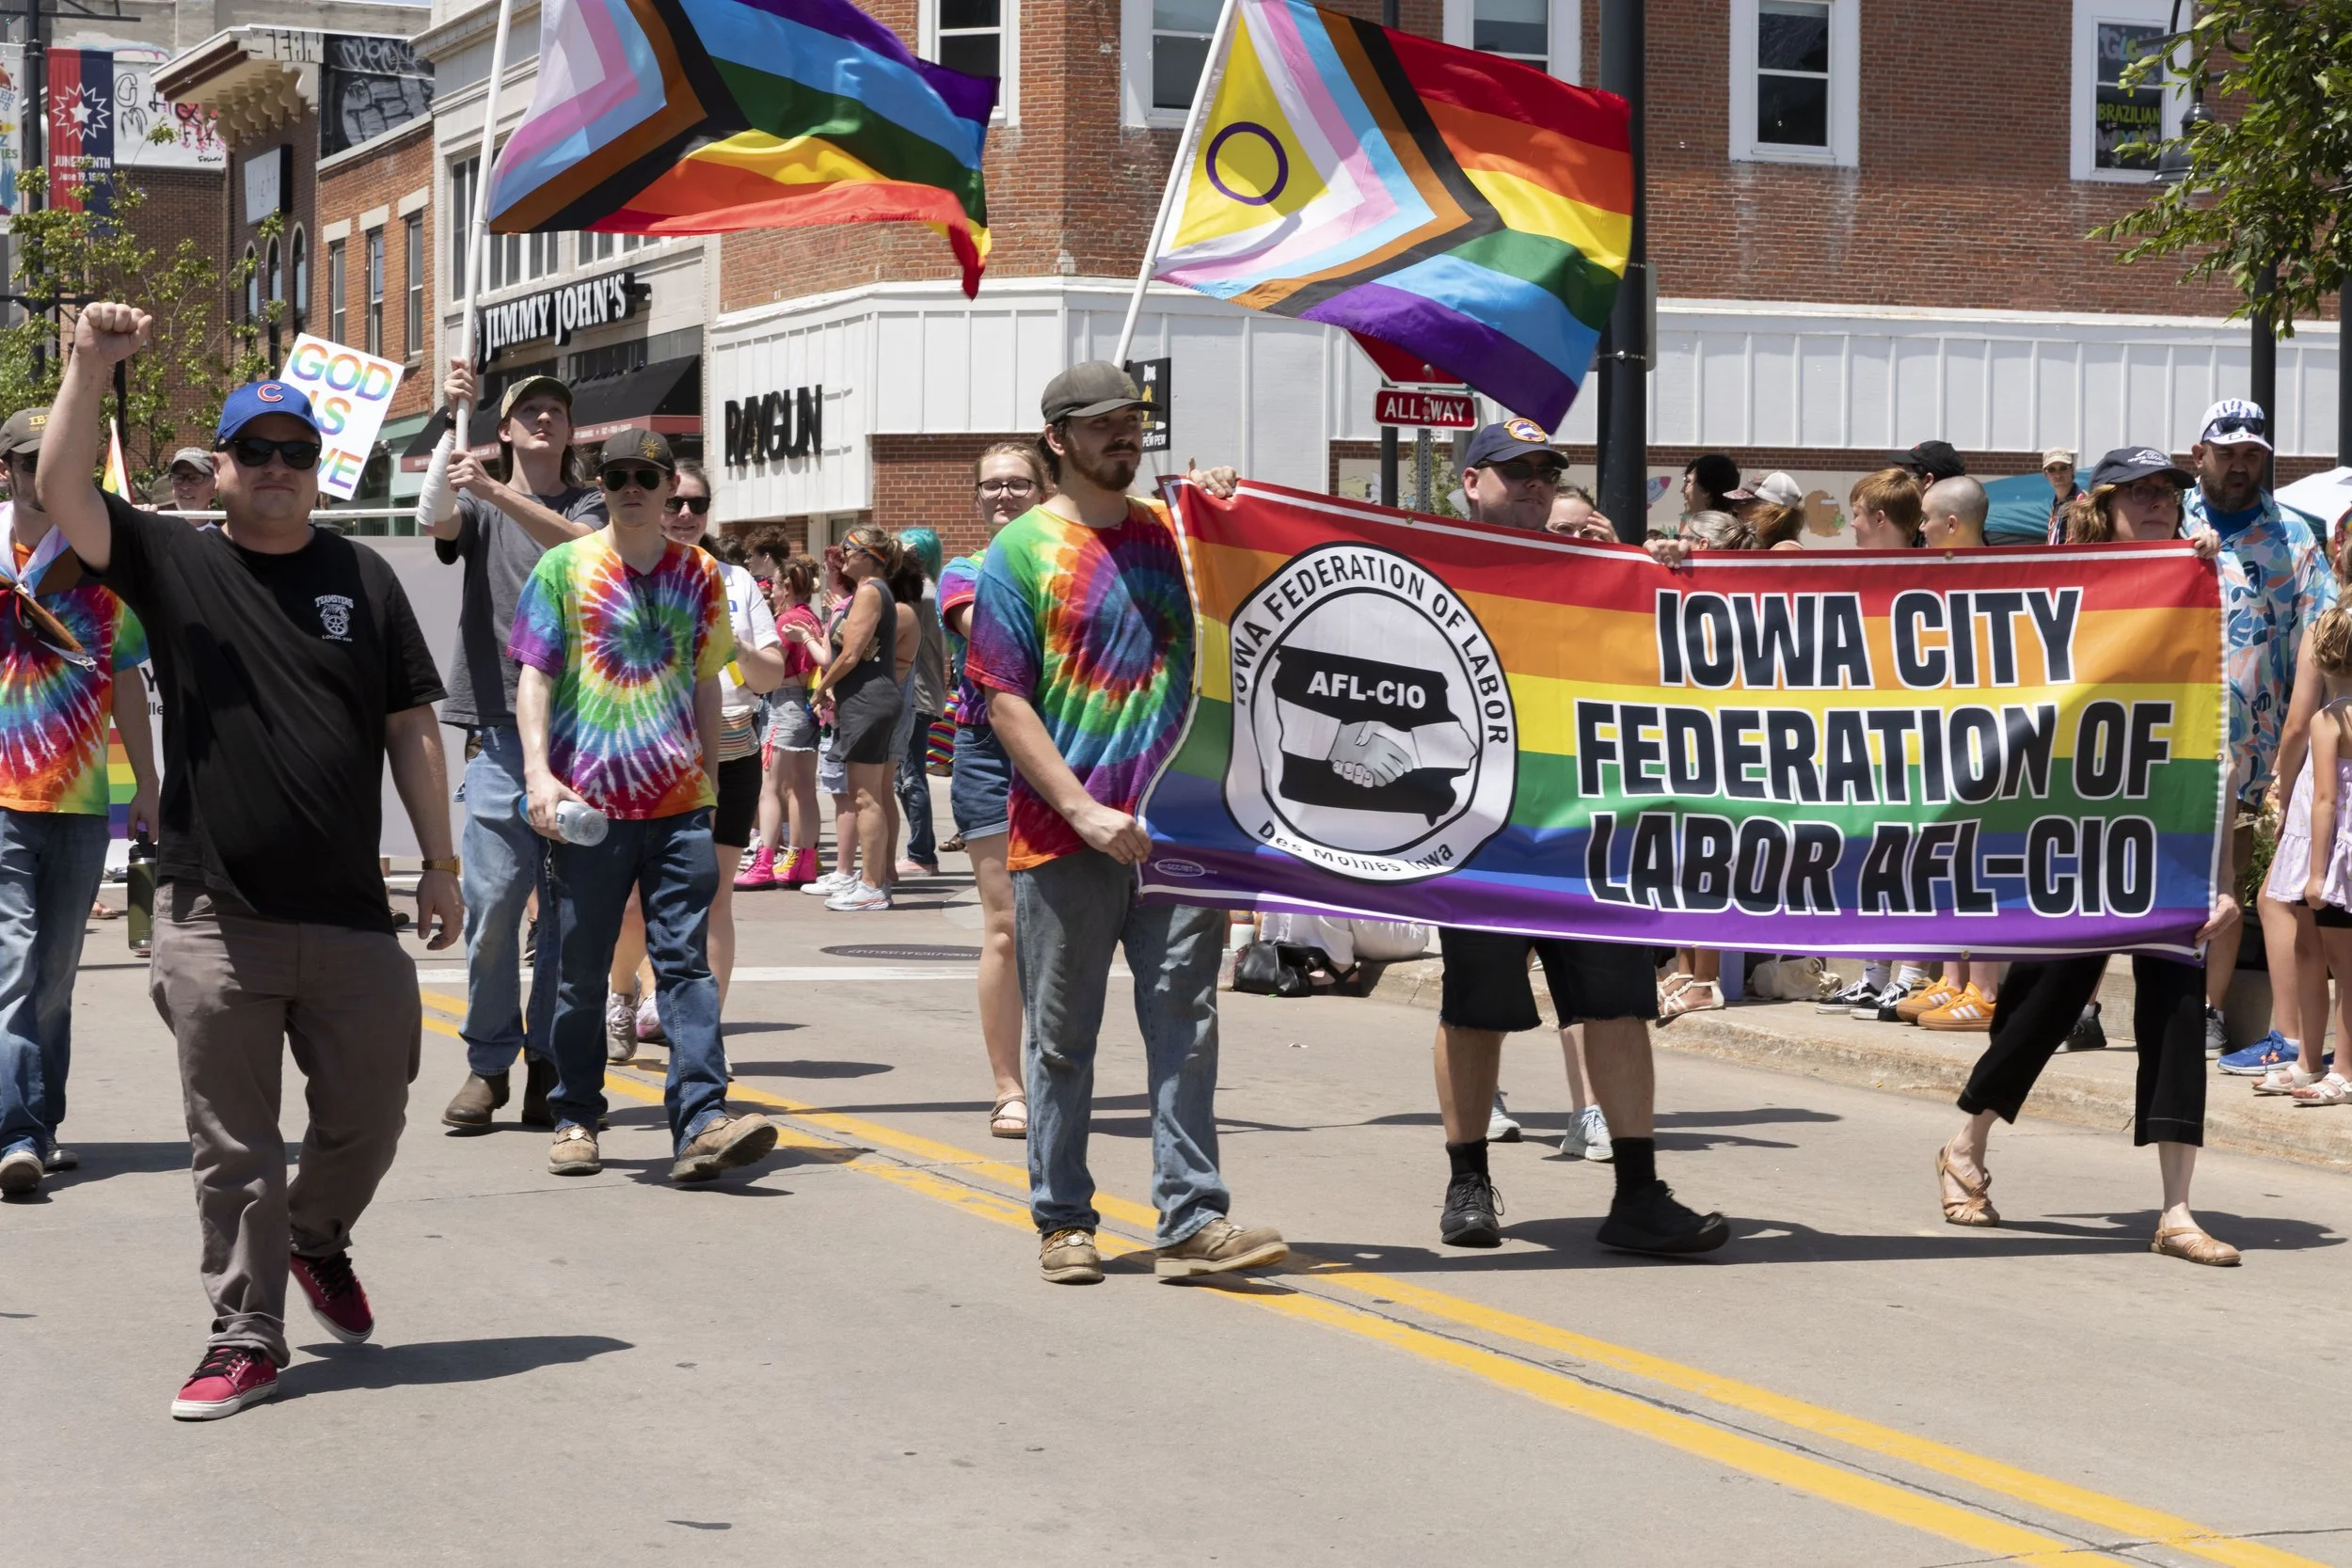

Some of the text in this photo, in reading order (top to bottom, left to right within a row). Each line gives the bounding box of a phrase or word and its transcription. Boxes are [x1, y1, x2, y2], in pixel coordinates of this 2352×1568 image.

[2098, 103, 2161, 124] BRAZILIAN
[54, 155, 111, 168] JUNETNTH
[58, 171, 76, 182] June
[88, 172, 106, 183] 185
[485, 293, 550, 362] JIMMY
[554, 273, 626, 346] JOHN'S
[291, 343, 393, 401] GOD
[725, 384, 822, 467] RAYGUN
[1384, 397, 1465, 421] ALL WAY
[1142, 435, 1167, 447] PEW PEW
[315, 594, 354, 609] TEAMSTERS
[1233, 554, 1508, 744] IOWA FEDERATION OF LABOR
[1656, 586, 2084, 689] IOWA CITY
[1307, 671, 1426, 709] AFL-CIO
[1574, 698, 2175, 806] FEDERATION OF
[1259, 821, 1454, 873] Des Moines Iowa
[1585, 811, 2157, 917] LABOR AFL-CIO
